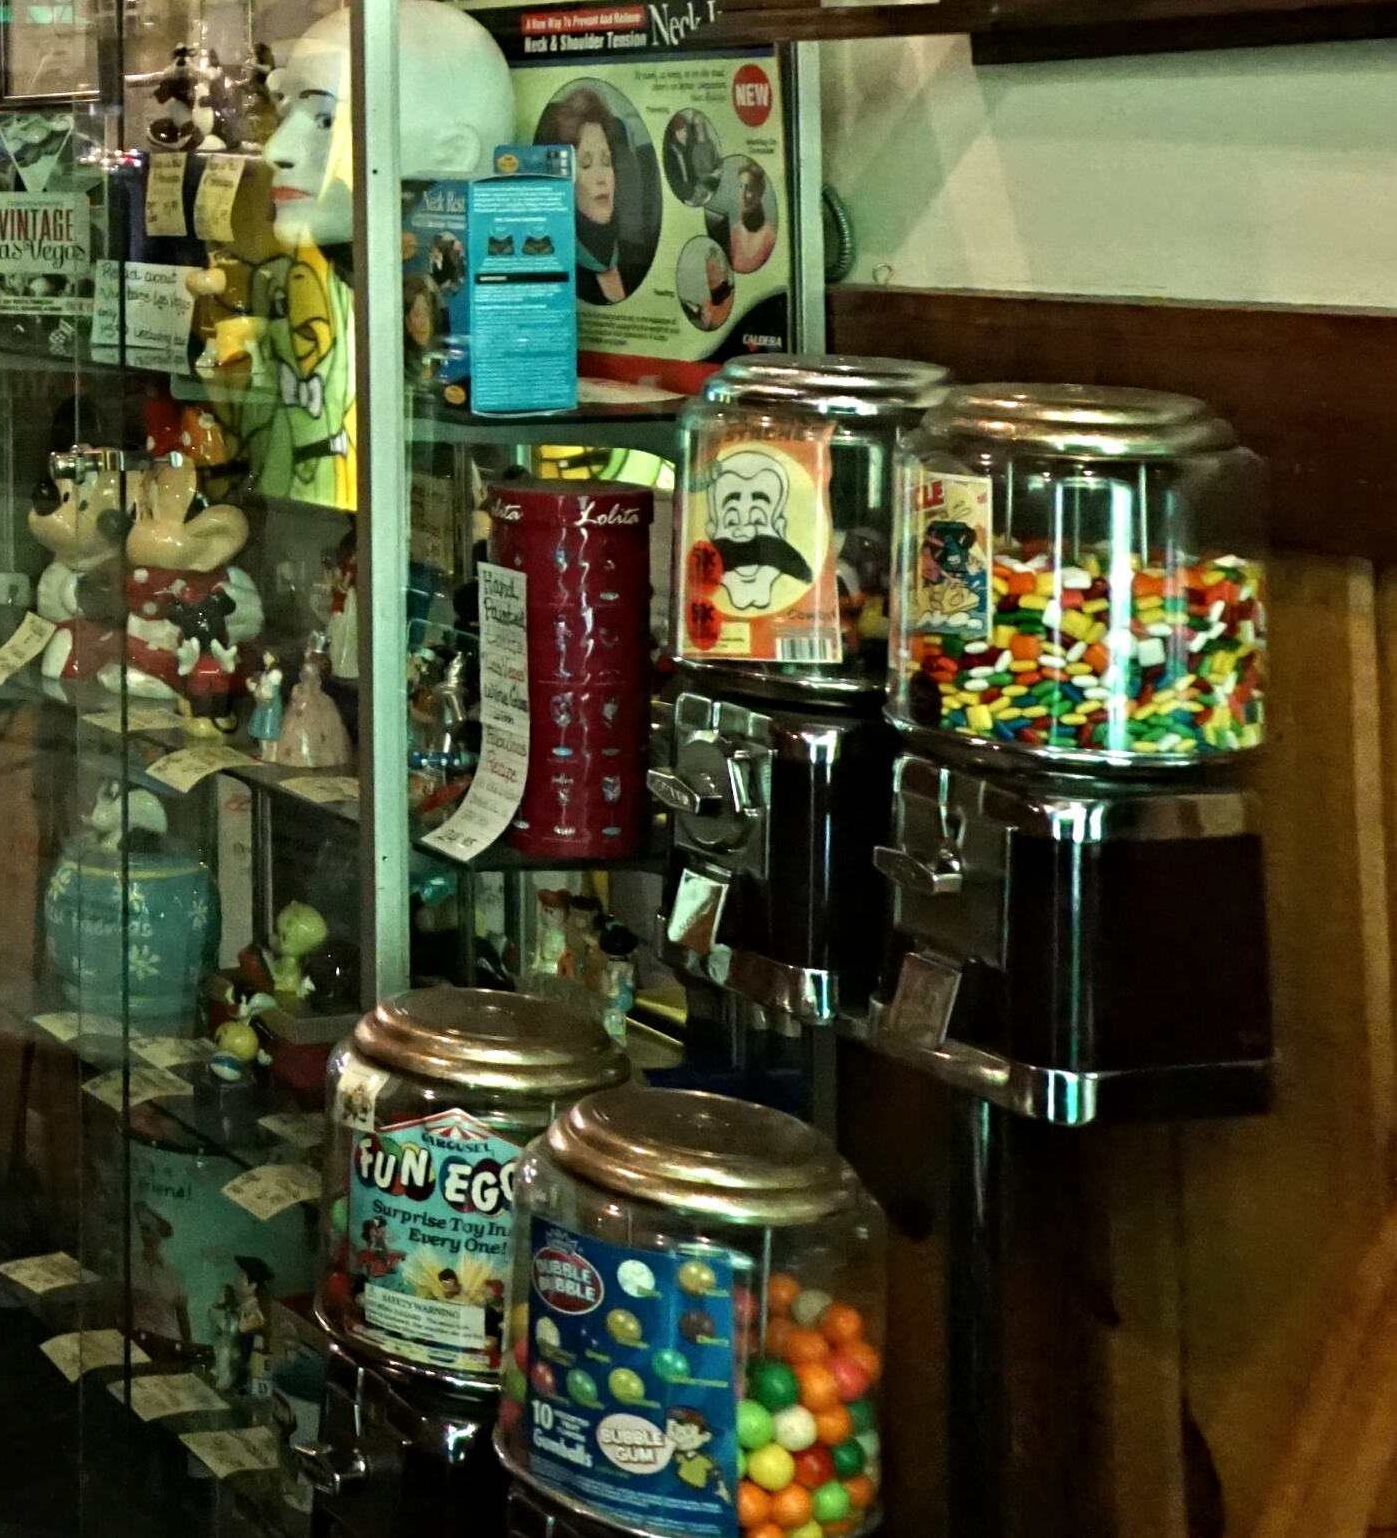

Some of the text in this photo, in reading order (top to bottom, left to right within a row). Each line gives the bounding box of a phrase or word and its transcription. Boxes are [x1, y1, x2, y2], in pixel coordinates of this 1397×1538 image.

[524, 36, 548, 53] Neck
[560, 33, 604, 52] Shoulder
[607, 30, 647, 48] Tension
[735, 83, 769, 107] NEW
[24, 237, 86, 268] Vegas
[145, 271, 178, 283] about
[574, 501, 640, 525] Lolita
[483, 570, 519, 600] Hand
[421, 1132, 494, 1153] CAROUSEL
[359, 1138, 514, 1212] FUN EGG
[372, 1200, 446, 1230] Surprise
[451, 1217, 484, 1238] Toy
[409, 1228, 507, 1255] Every One!
[531, 1399, 553, 1429] 10
[600, 1428, 665, 1447] BUBBLE
[615, 1446, 657, 1464] GUM
